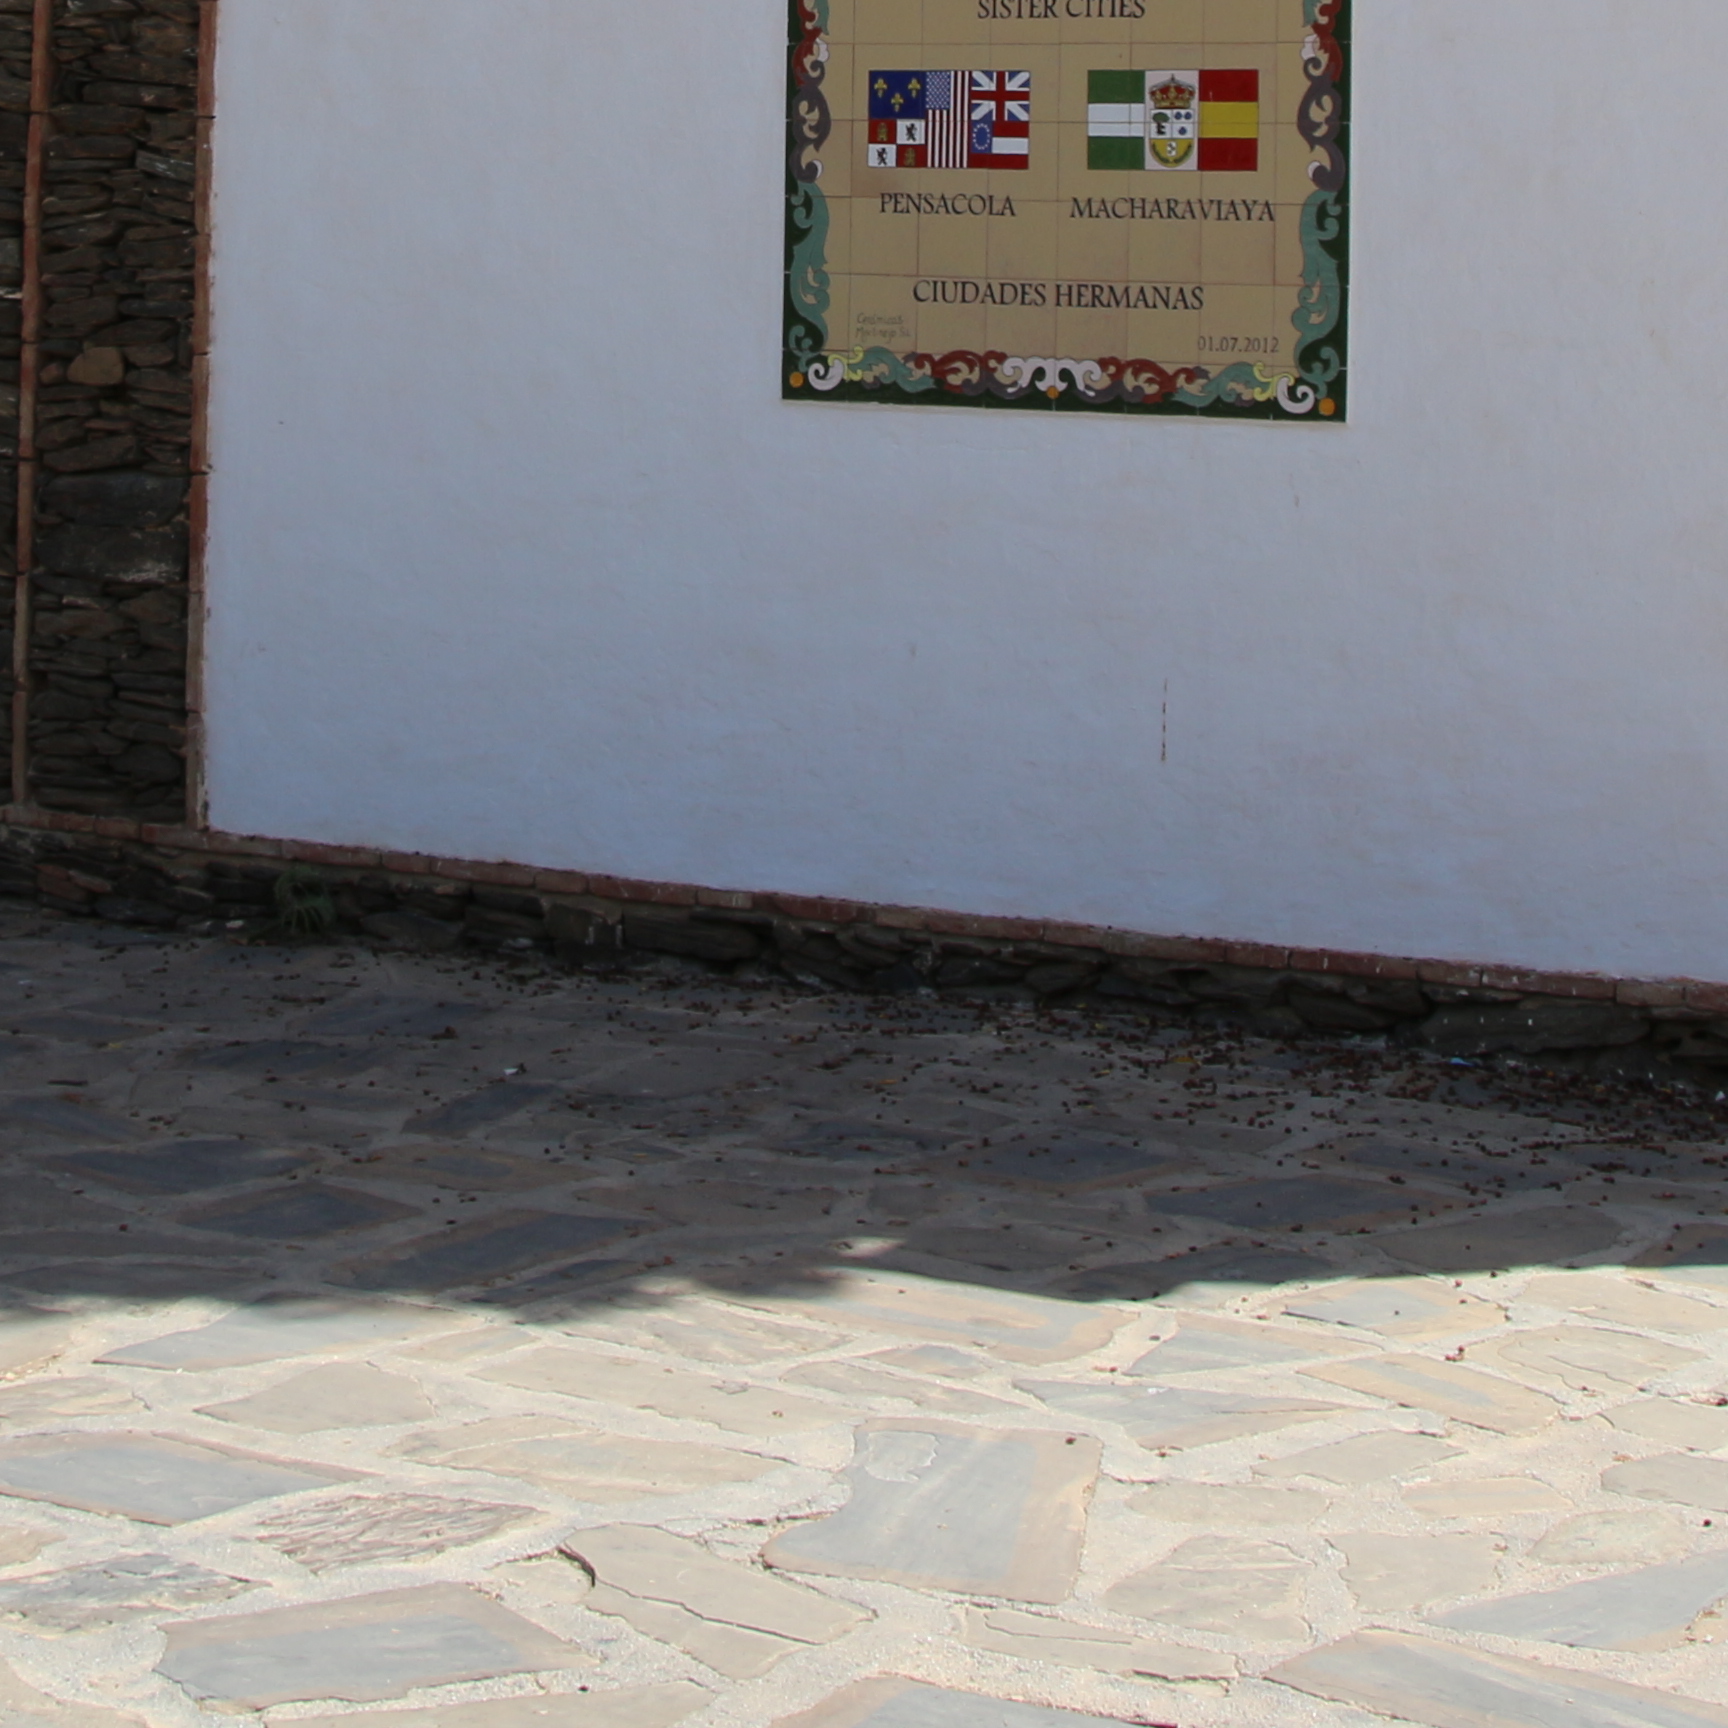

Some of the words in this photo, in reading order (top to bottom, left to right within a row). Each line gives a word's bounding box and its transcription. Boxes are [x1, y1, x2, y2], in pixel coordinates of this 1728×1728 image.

[878, 192, 1017, 218] PENSACOLA
[1068, 197, 1276, 223] MACHARAVIAYA
[912, 279, 1047, 308] CIUDADES
[1054, 283, 1205, 311] HERMANAS
[1197, 335, 1280, 354] 01.07.2012
